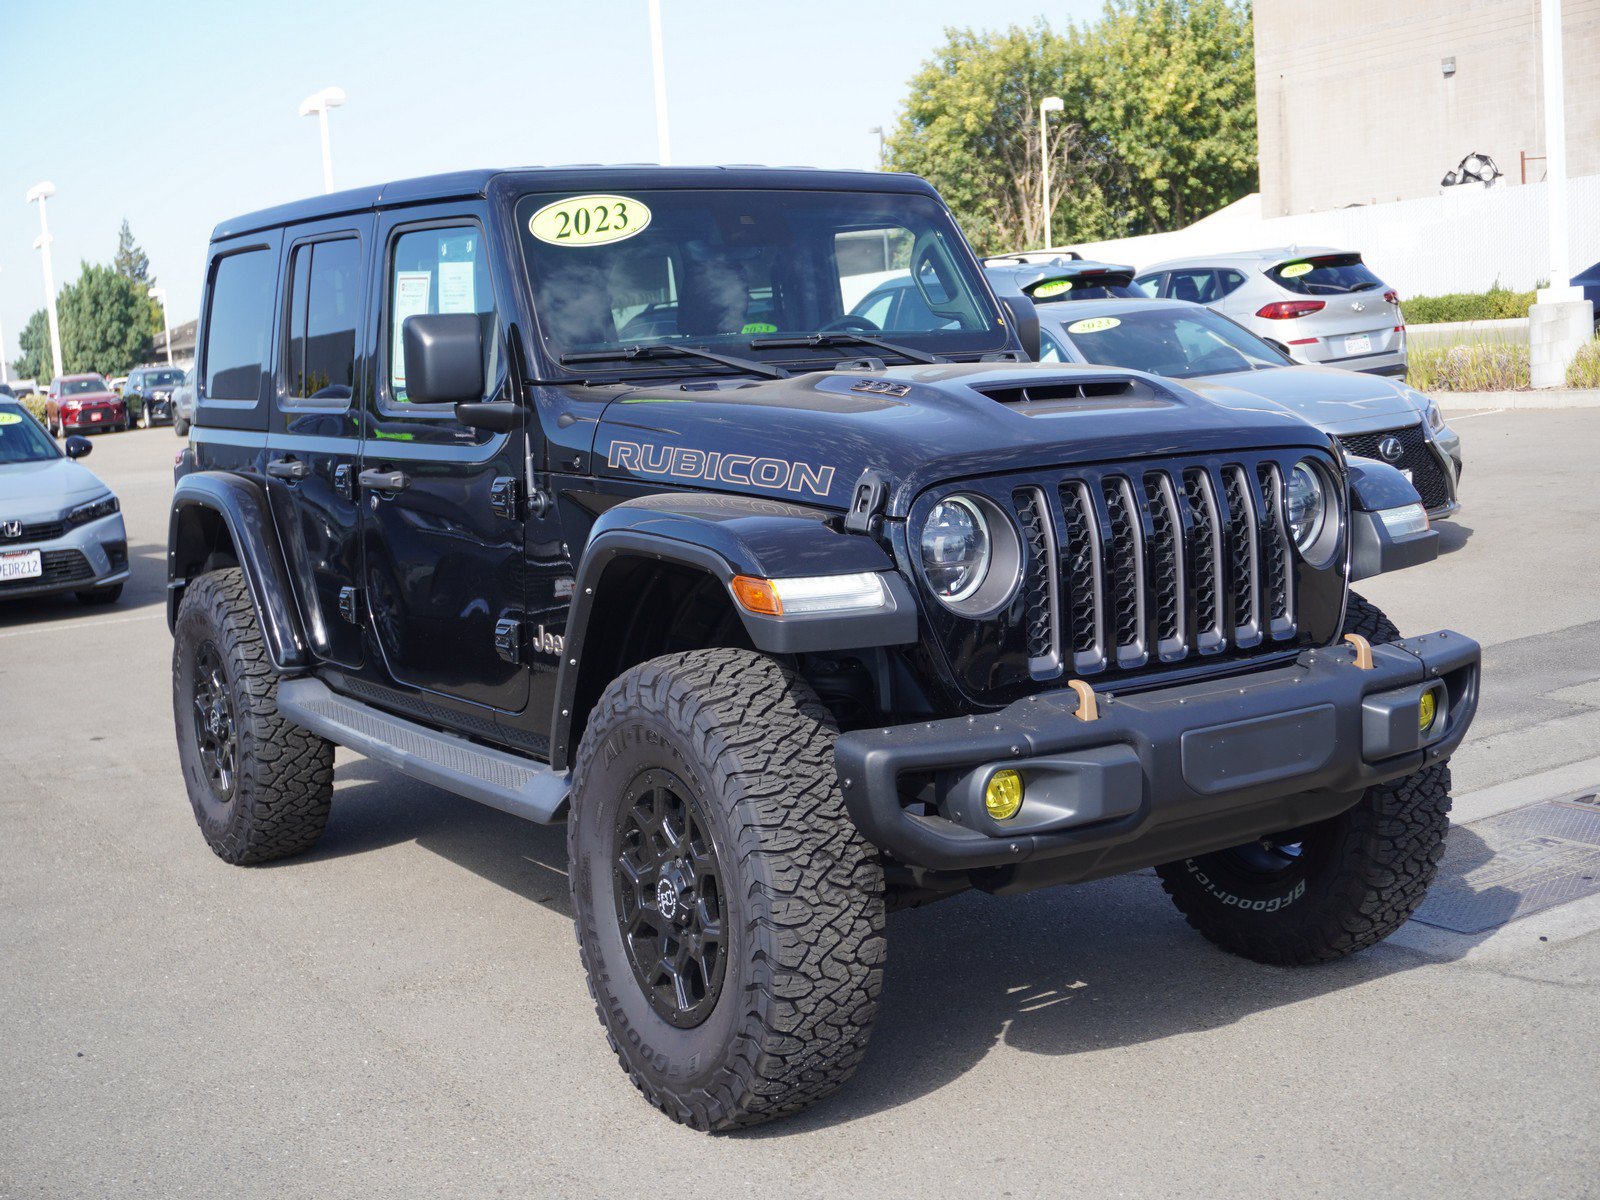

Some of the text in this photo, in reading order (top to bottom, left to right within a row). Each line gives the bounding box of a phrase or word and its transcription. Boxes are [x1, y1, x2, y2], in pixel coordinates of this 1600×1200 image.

[554, 202, 628, 239] 2023
[1081, 319, 1111, 331] 2023
[608, 440, 836, 496] RUBICON
[0, 560, 38, 577] EDR212
[533, 624, 565, 656] Jee
